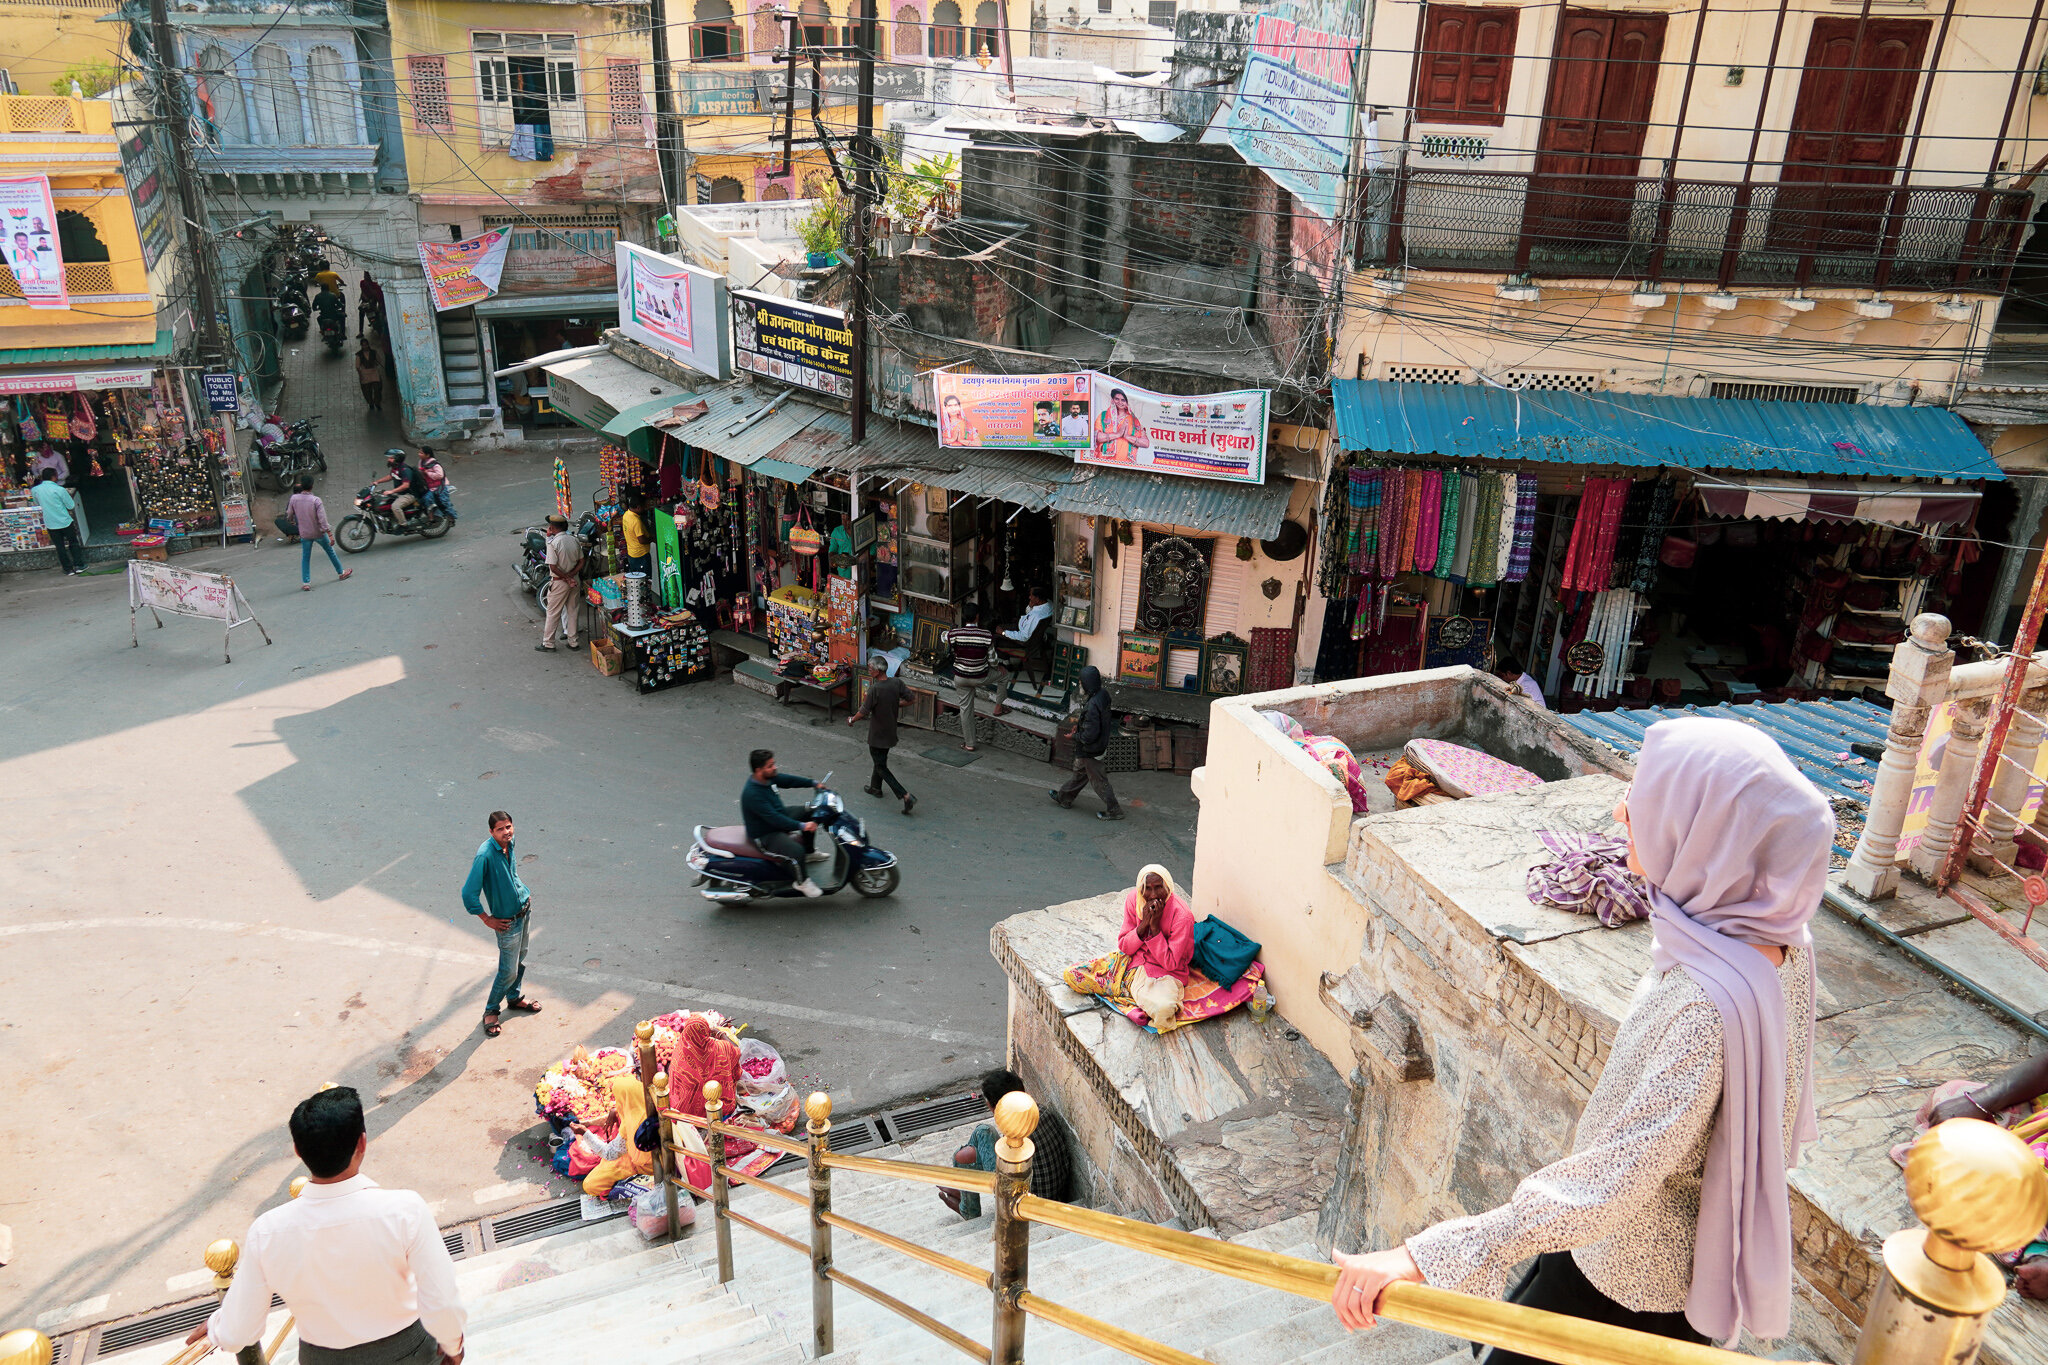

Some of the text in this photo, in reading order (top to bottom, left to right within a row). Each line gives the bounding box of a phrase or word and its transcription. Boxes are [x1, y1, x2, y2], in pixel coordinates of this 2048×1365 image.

[722, 91, 755, 101] Roof Top
[697, 100, 763, 114] RESTAURA
[460, 240, 481, 252] 53
[757, 308, 769, 326] श्री
[769, 313, 805, 335] जगन्नाथ
[805, 320, 823, 340] भोग
[823, 327, 854, 347] सामग्री
[666, 348, 675, 357] PAN
[761, 333, 850, 365] एवं धार्मिक केन्द्र
[96, 375, 143, 384] MAGNET
[554, 379, 567, 393] FOUR
[962, 377, 985, 387] उदयपुर
[986, 377, 1001, 385] नगर
[1001, 376, 1021, 385] निगम
[1022, 377, 1040, 387] चुनाव
[1047, 377, 1068, 385] 2019
[551, 388, 571, 408] SQUARE
[1150, 427, 1256, 453] तारा शर्मा (सुथार)
